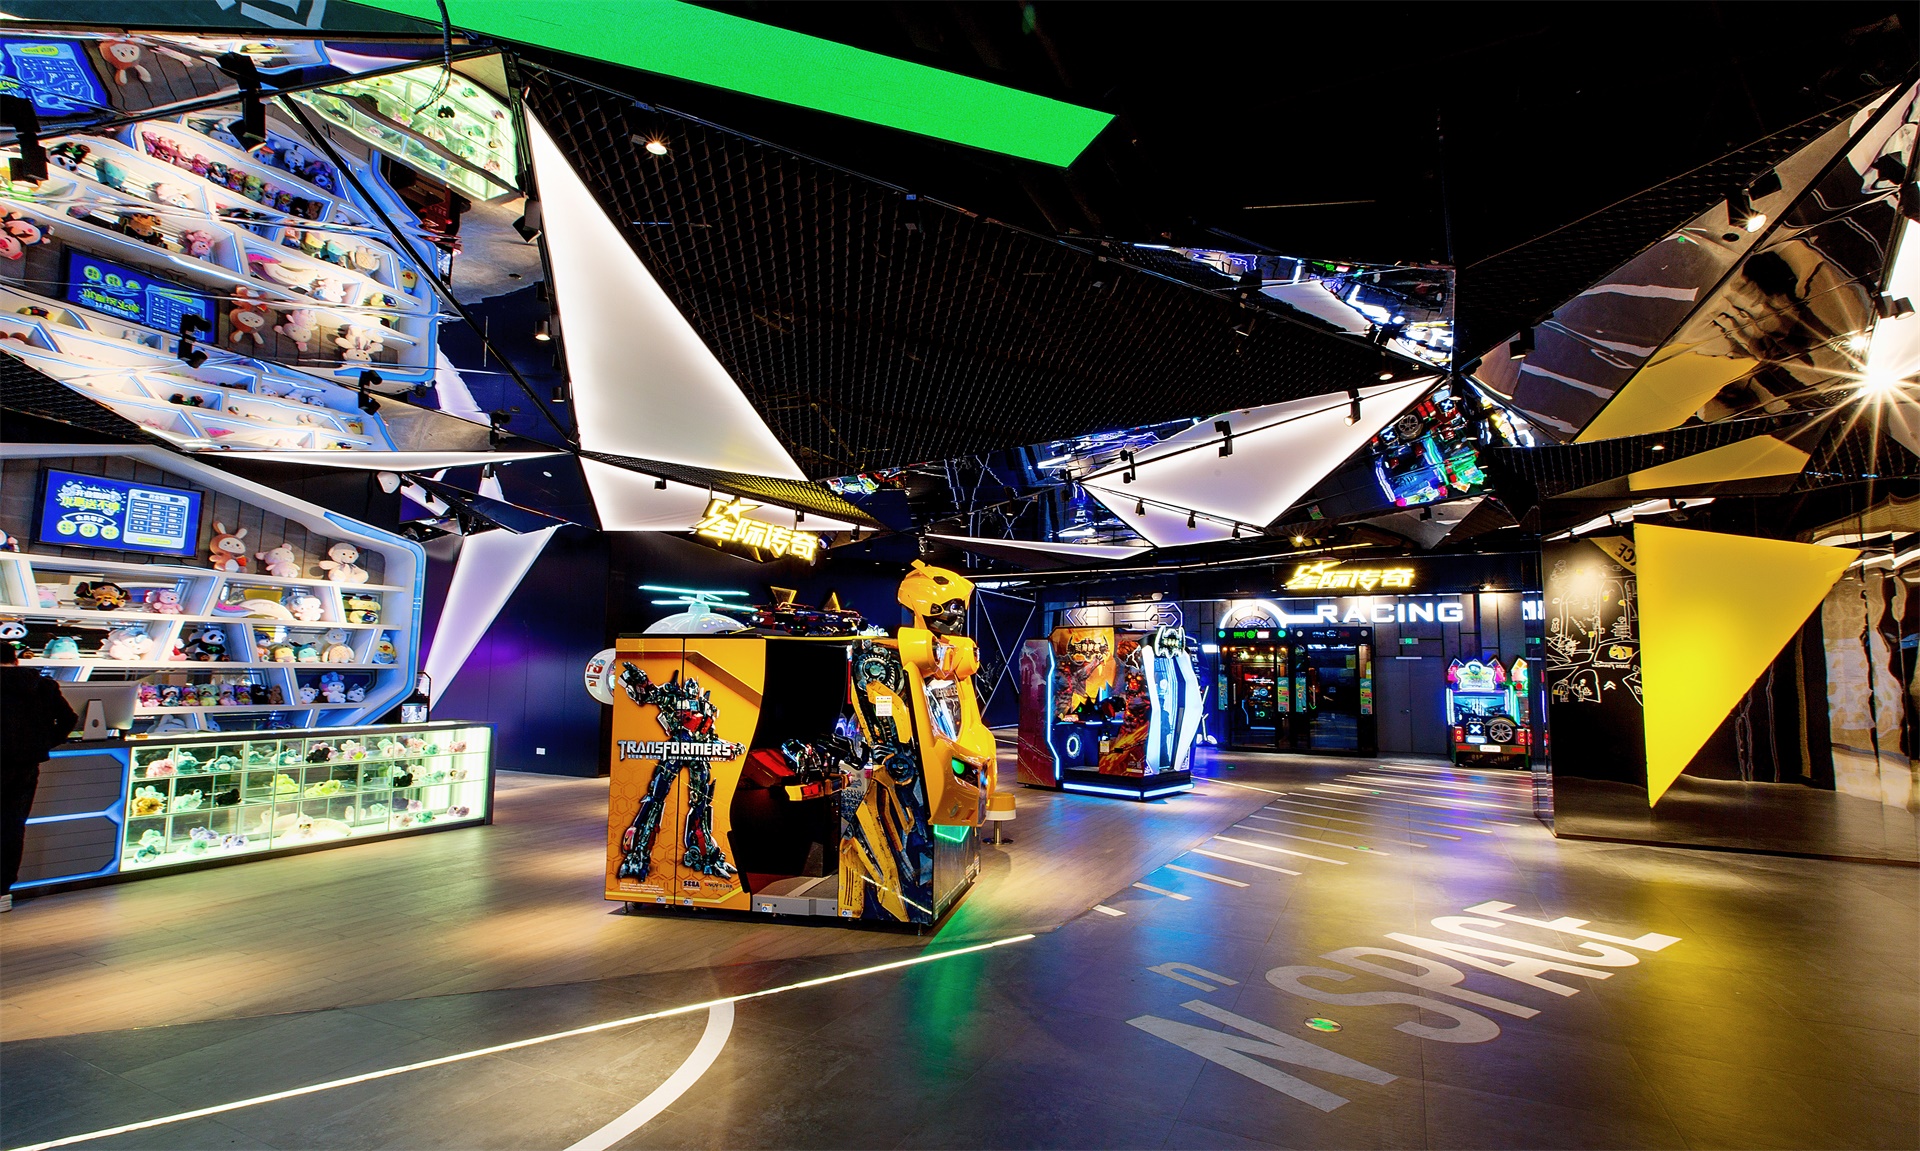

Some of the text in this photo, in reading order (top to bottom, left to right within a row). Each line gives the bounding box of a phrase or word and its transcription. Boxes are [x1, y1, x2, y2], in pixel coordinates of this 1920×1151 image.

[696, 498, 818, 561] 星际传奇
[1284, 560, 1416, 591] 星际传奇
[1316, 602, 1464, 624] RACING
[617, 740, 732, 761] TRANSFORMERS
[683, 880, 701, 888] SEGA
[1265, 900, 1683, 1044] SPACE
